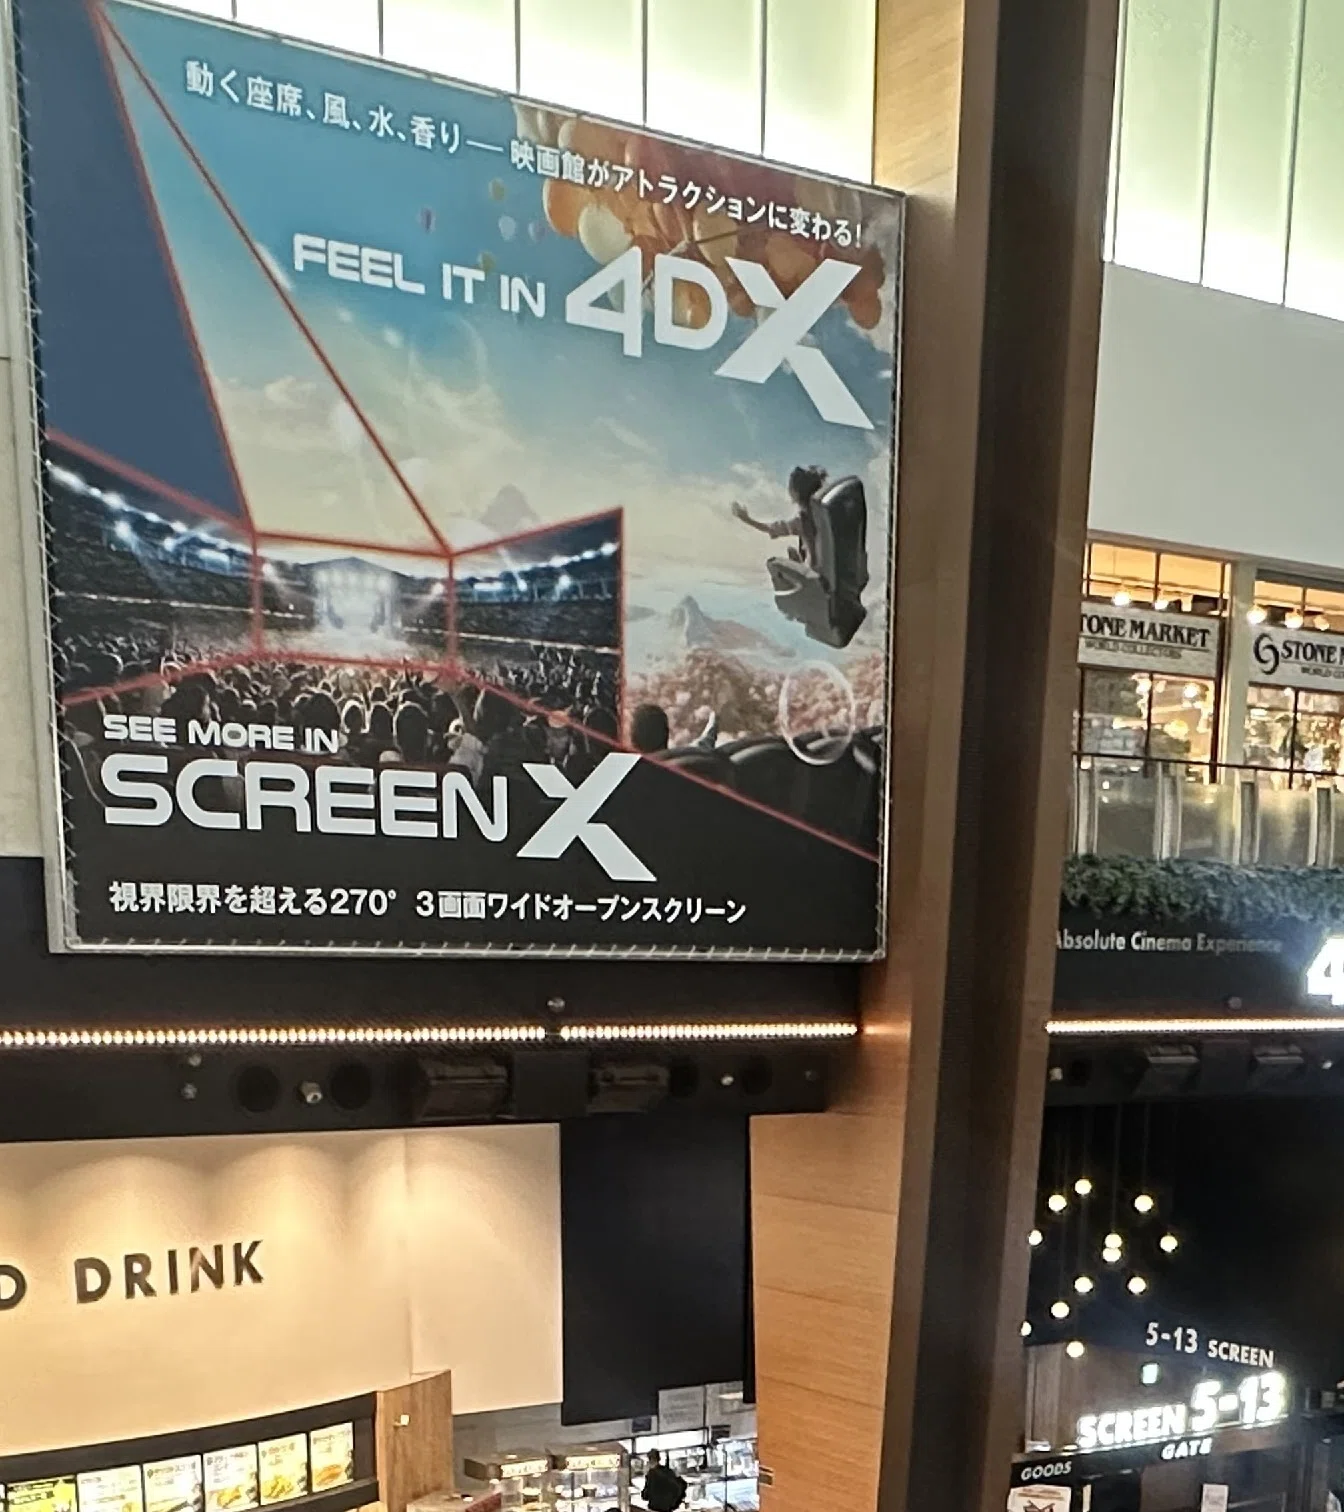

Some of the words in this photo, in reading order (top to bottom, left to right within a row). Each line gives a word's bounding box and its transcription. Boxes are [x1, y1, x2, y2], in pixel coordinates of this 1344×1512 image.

[292, 232, 425, 294] FEEL
[441, 262, 485, 303] IT
[499, 274, 546, 318] IN
[565, 246, 875, 430] 4DX
[1081, 613, 1127, 637] TONE
[1129, 619, 1211, 648] MARKET
[1280, 639, 1337, 664] STONE
[103, 714, 177, 747] SEE
[187, 719, 295, 751] MORE
[302, 726, 339, 755] IN
[415, 889, 747, 926] 3画面ワイドオープンスクリーン
[1130, 931, 1192, 952] Cinema
[1197, 933, 1283, 956] Experience
[74, 1240, 264, 1305] DRINK
[1145, 1322, 1198, 1354] 5-13
[1207, 1339, 1275, 1368] SCREEN
[1076, 1402, 1187, 1449] SCREEN
[1188, 1371, 1288, 1432] 5-13
[1161, 1437, 1213, 1461] GATE
[1020, 1460, 1072, 1482] GOODS
